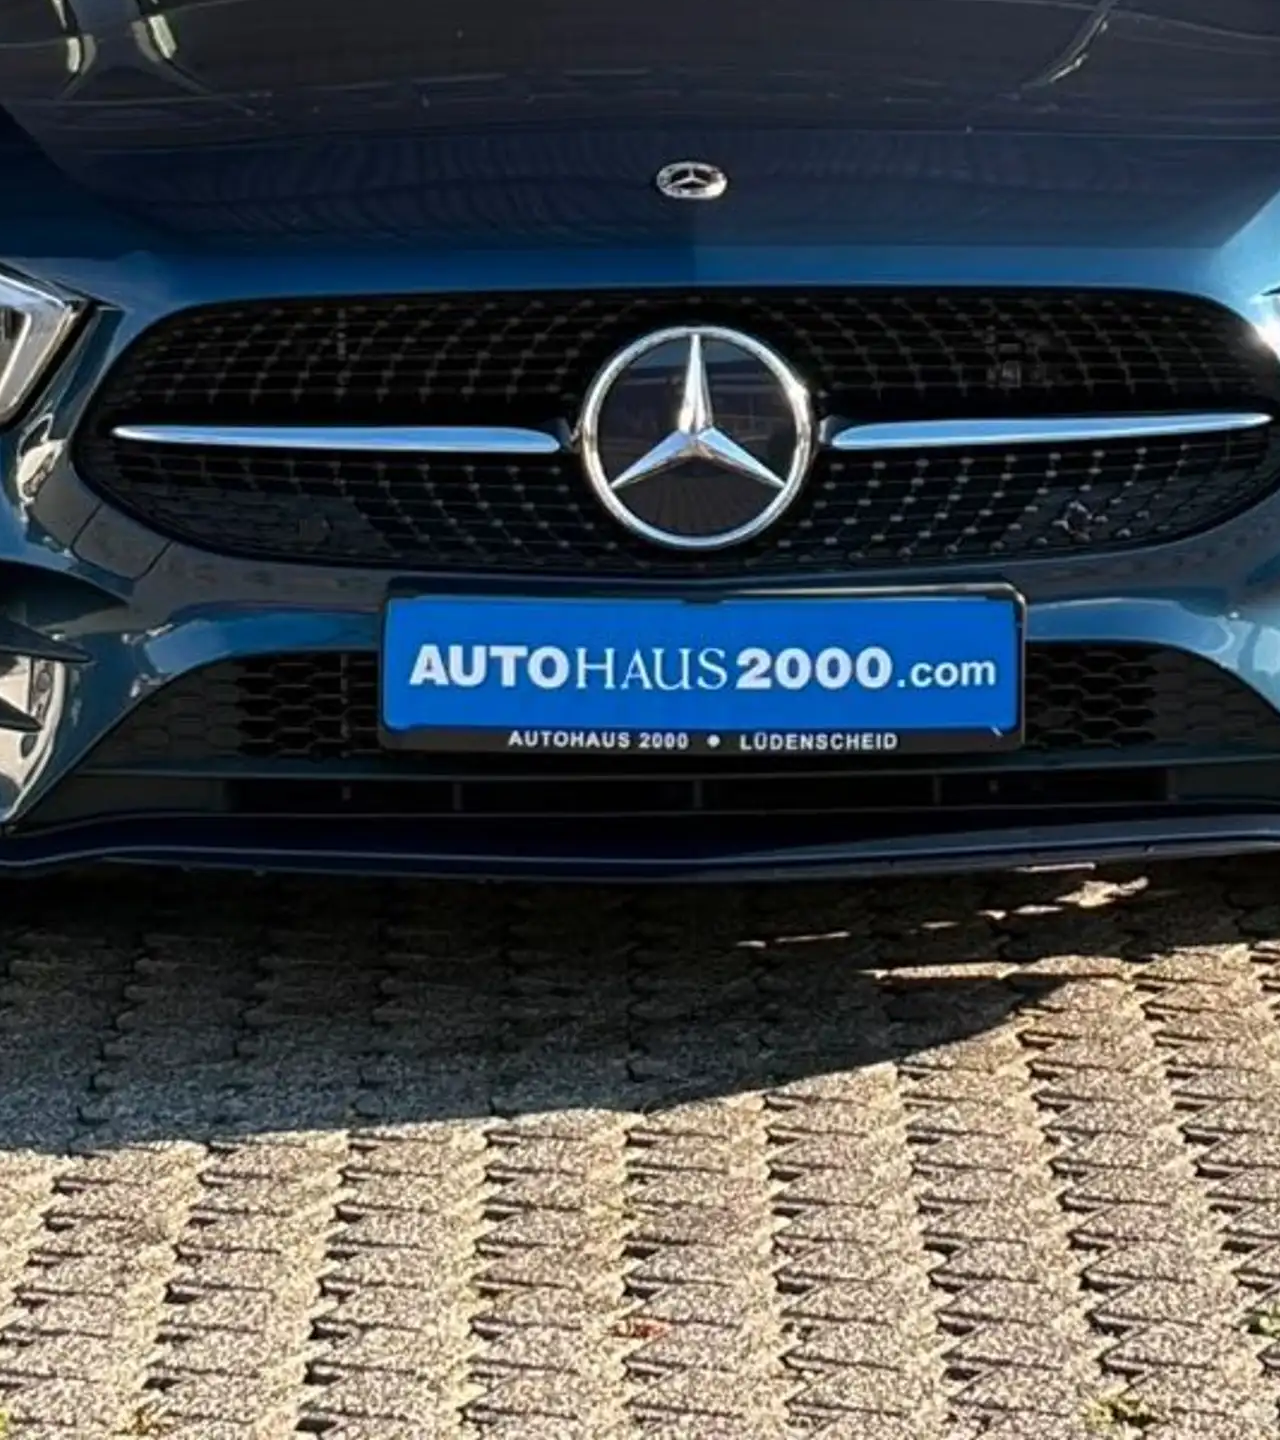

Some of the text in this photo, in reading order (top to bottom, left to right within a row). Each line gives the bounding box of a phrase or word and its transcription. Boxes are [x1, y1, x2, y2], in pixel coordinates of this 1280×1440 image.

[507, 730, 899, 751] AUTOHAUS 2000 LÜDENSCHEID
